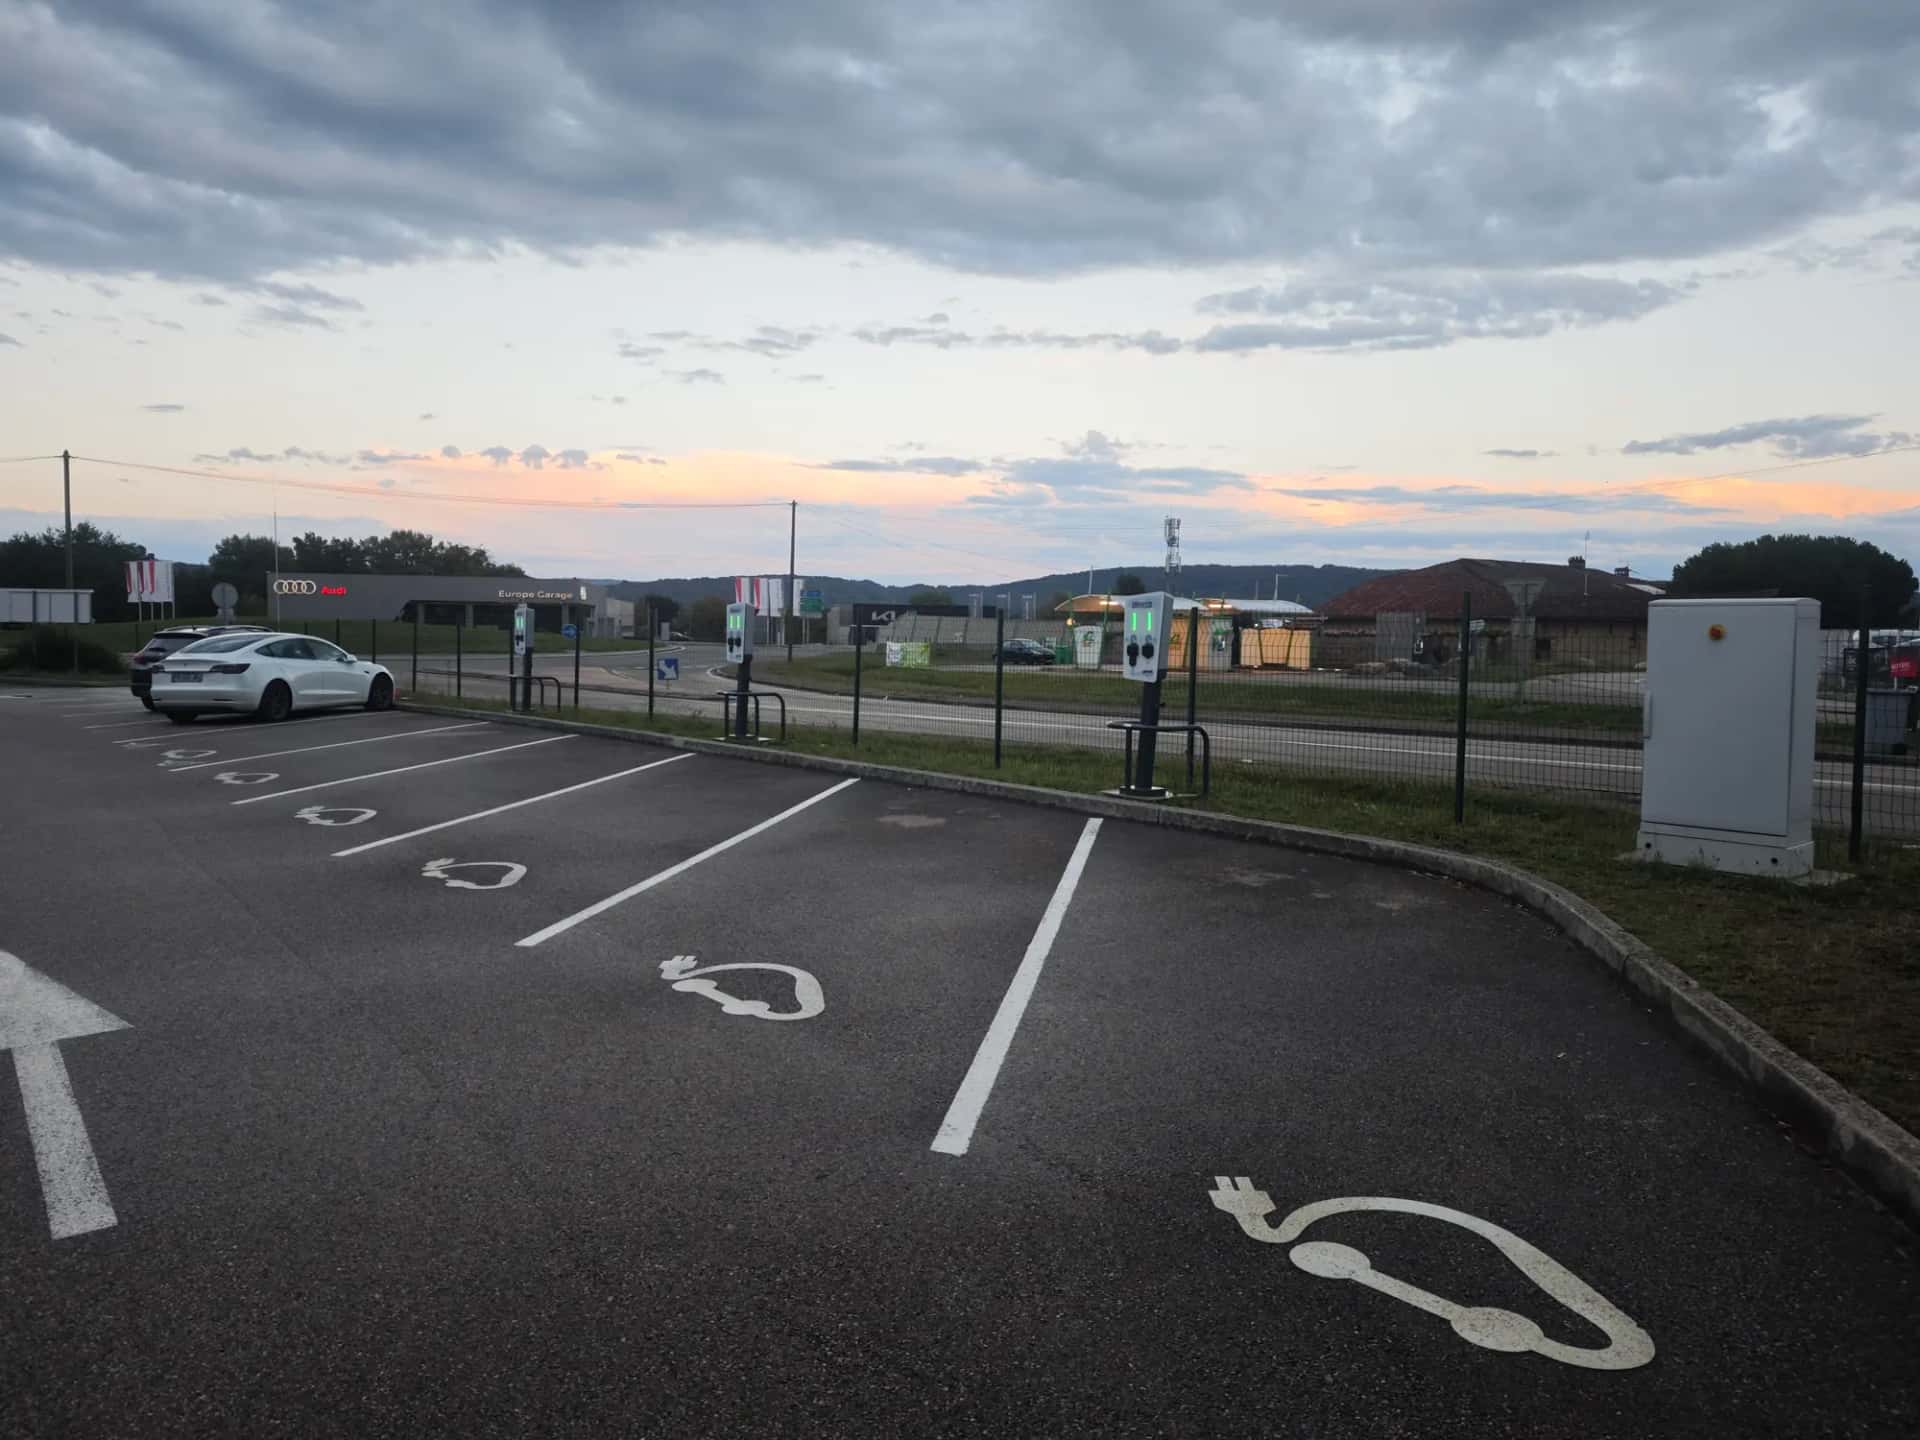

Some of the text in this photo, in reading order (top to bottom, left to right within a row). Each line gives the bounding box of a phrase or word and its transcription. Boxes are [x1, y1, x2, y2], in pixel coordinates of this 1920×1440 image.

[321, 586, 347, 596] Audi
[498, 590, 573, 600] Europe Garage
